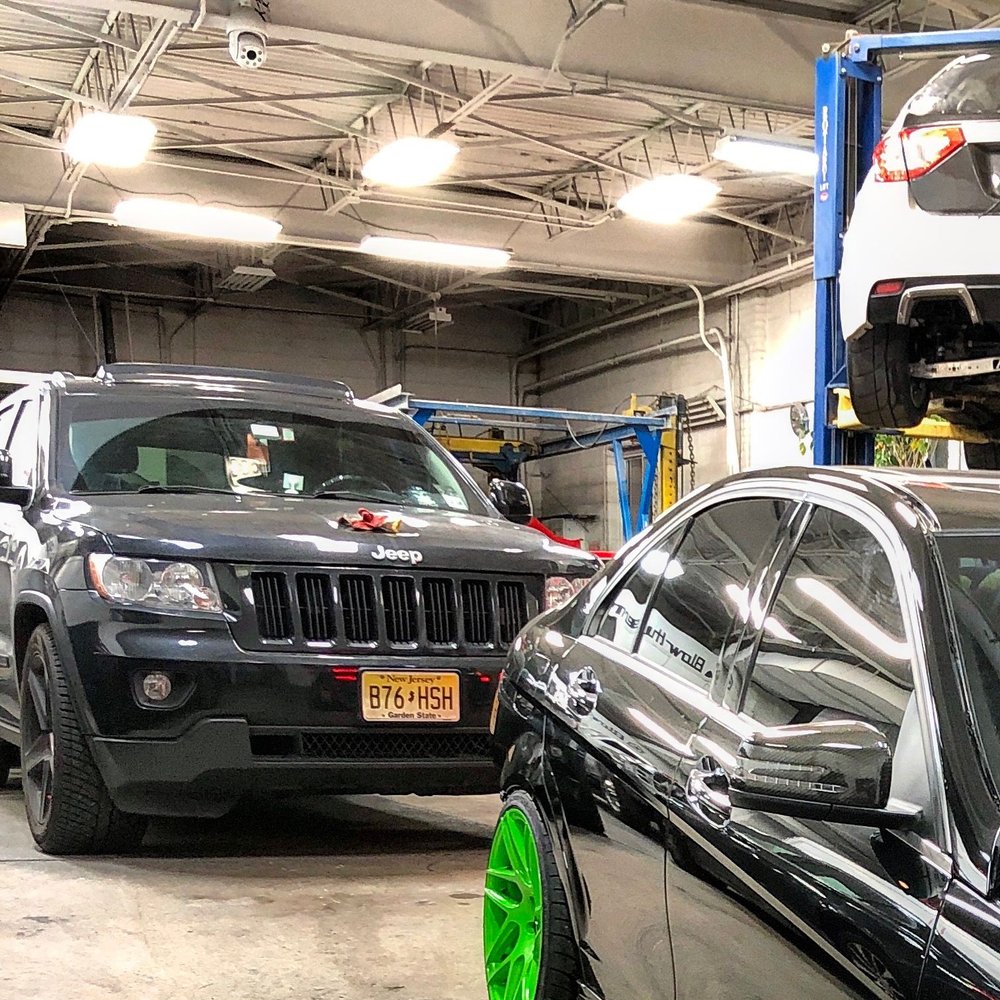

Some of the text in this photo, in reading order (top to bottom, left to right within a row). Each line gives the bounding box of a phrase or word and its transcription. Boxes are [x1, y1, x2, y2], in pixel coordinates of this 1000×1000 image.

[371, 544, 423, 565] Jeep
[386, 674, 434, 684] New Jersey
[369, 685, 453, 710] B76 HSH
[388, 711, 415, 719] Garden
